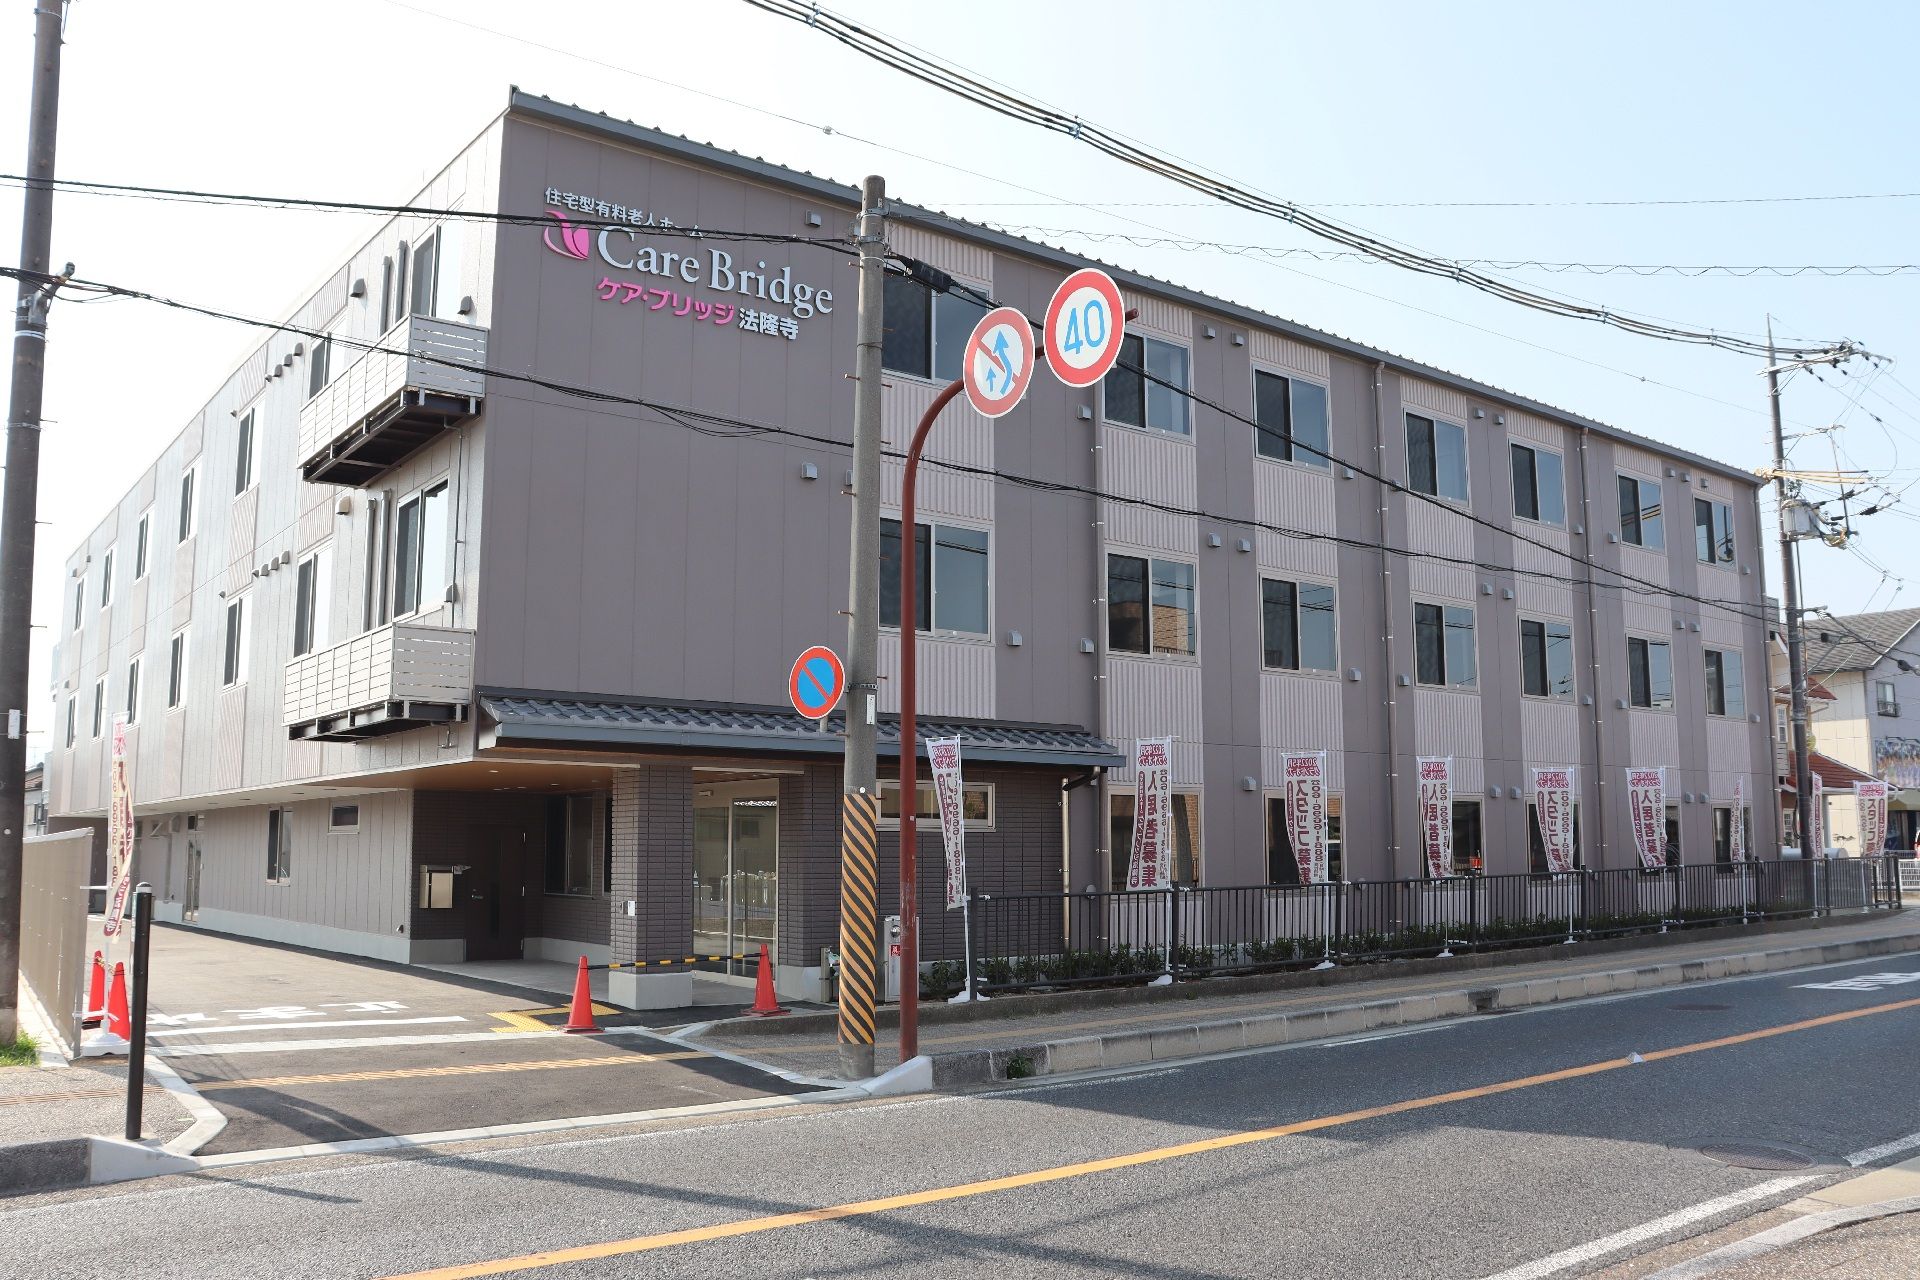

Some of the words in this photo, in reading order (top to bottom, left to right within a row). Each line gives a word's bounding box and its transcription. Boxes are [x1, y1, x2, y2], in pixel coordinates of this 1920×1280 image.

[545, 187, 703, 240] 住宅型有料老人ホム
[598, 225, 700, 283] Care
[708, 248, 833, 319] Bridge
[597, 277, 735, 325] ケア・ブリッジ
[738, 307, 799, 340] 法隆寺
[1064, 299, 1106, 355] 40
